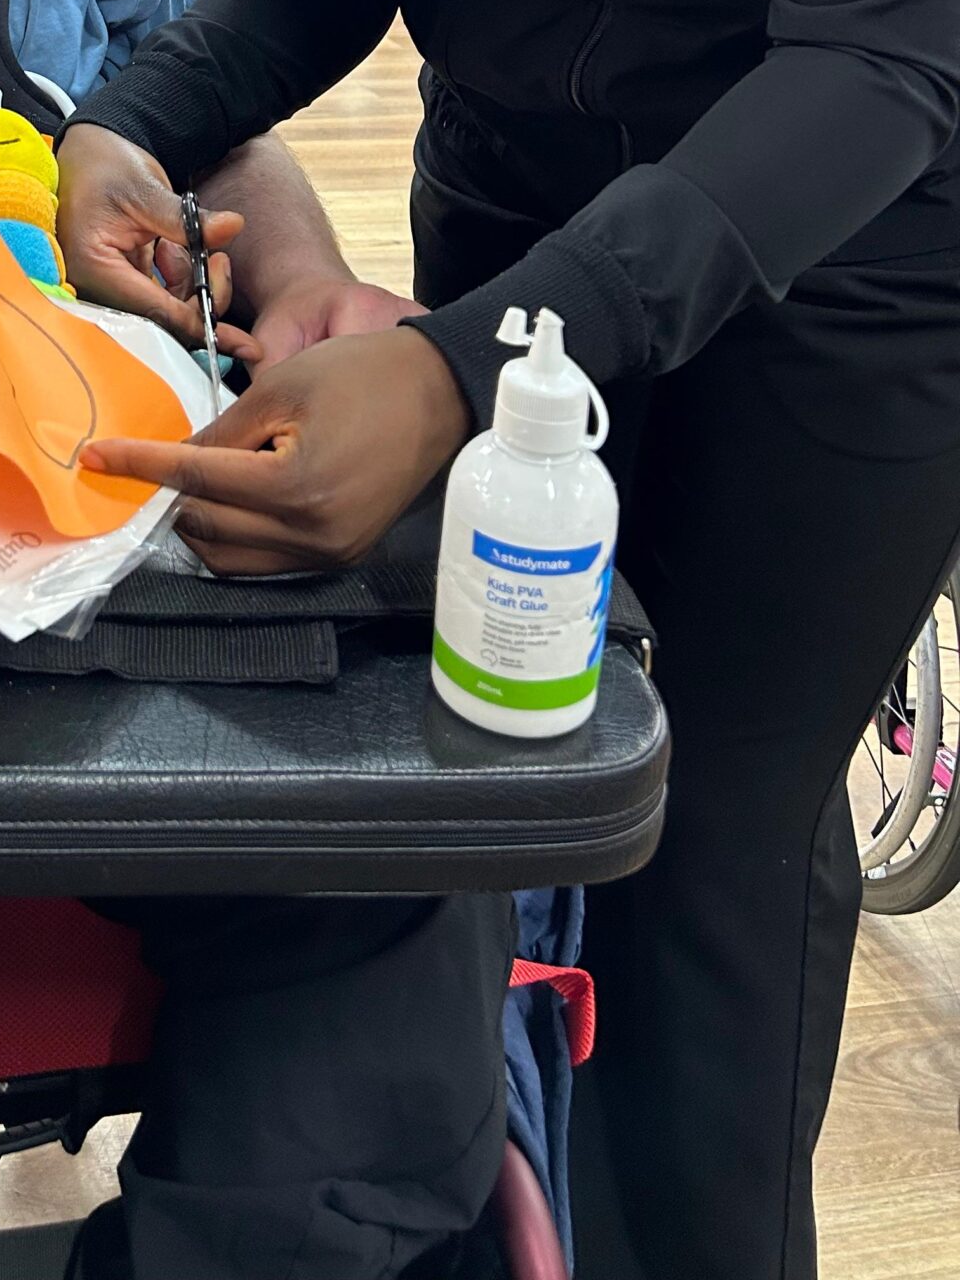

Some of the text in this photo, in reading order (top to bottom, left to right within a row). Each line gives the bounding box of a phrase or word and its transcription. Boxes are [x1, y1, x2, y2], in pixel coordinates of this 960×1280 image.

[500, 553, 571, 572] studymate
[487, 576, 544, 598] Kids PVA
[486, 590, 549, 611] Craft Glue
